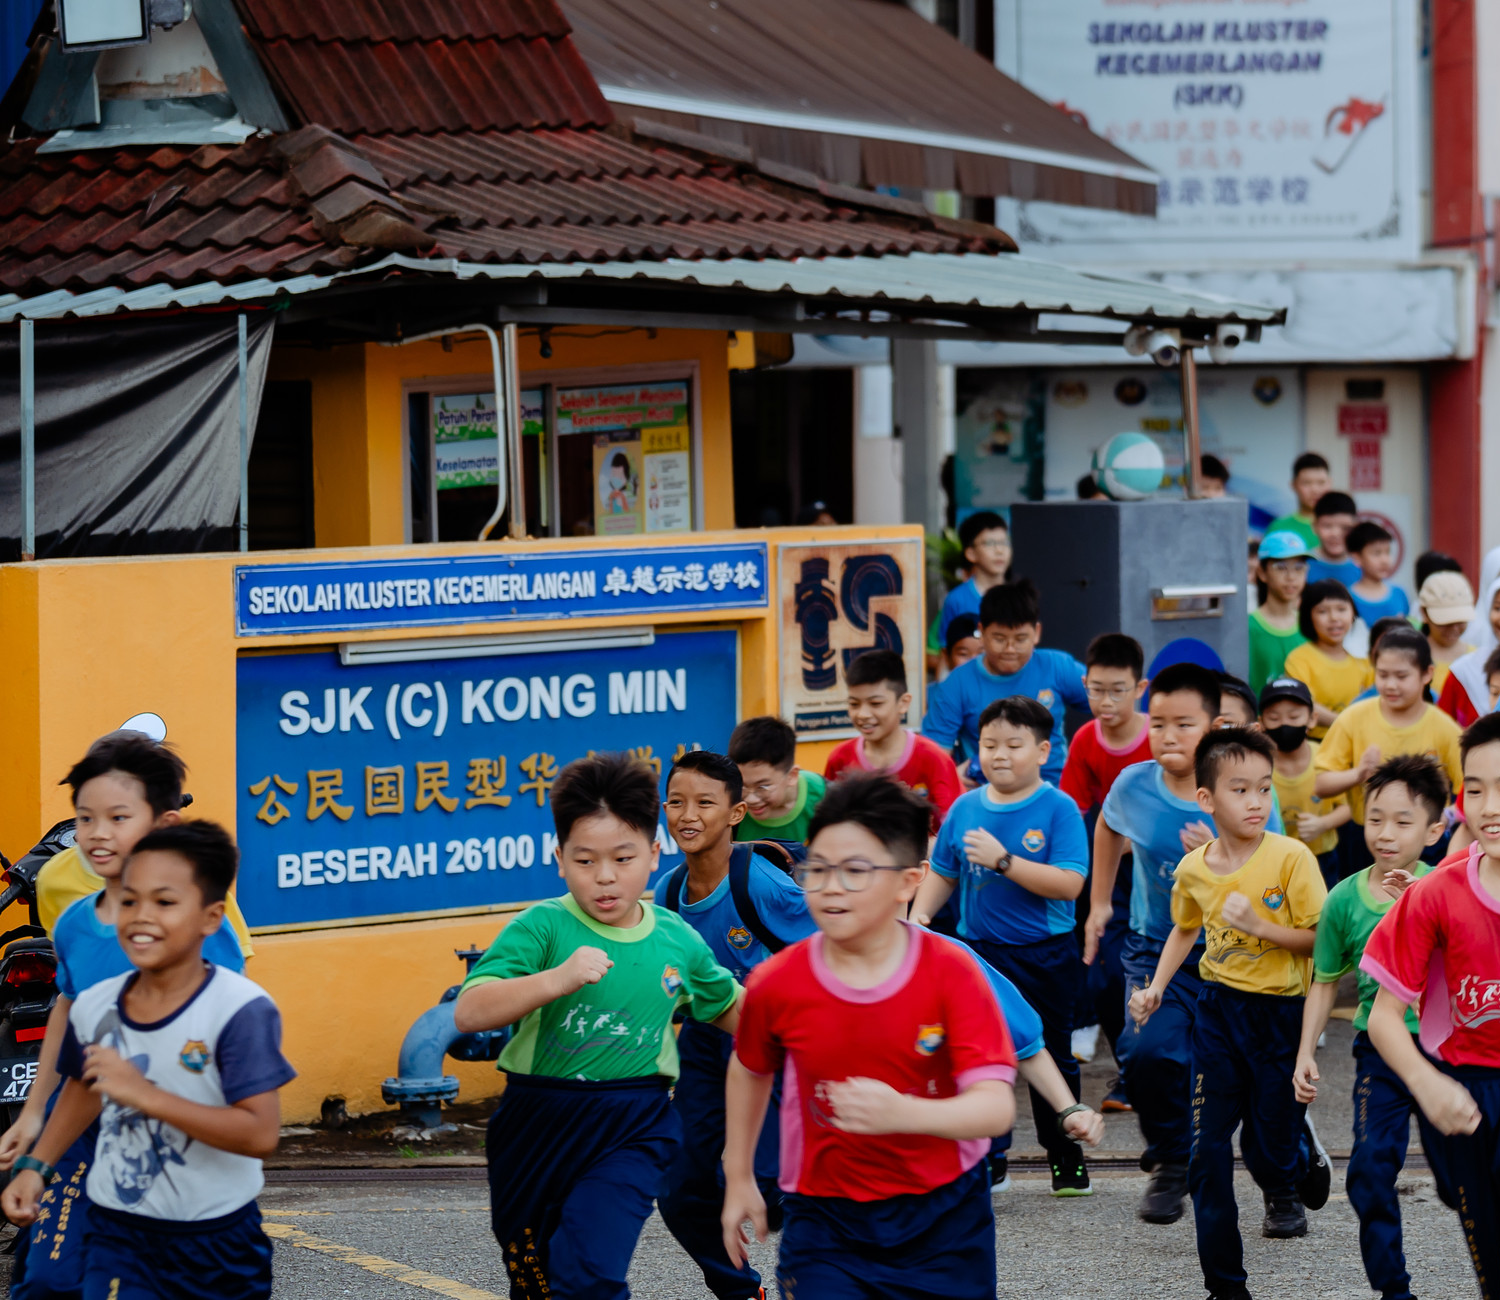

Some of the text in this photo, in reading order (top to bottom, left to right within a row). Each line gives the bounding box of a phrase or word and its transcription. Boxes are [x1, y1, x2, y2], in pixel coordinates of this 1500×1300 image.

[1088, 20, 1329, 46] SEKOLAH KLUSTER
[1095, 52, 1322, 76] KECEMERLANGAN
[1174, 83, 1244, 110] (SKK)
[560, 393, 596, 411] Sekolah
[598, 391, 636, 408] Selamat
[438, 407, 497, 427] Patuhi Perat
[572, 406, 675, 428] Kecemerlangan Murid
[436, 457, 498, 473] Keselamatan
[248, 559, 762, 616] SEKOLAH KLUSTER KECEMERLANGAN 卓越示范学校
[279, 668, 688, 740] SJK (C) KONG MIN
[276, 840, 438, 890] BESERAH
[445, 833, 537, 877] 26100
[524, 1256, 539, 1264] (C)
[532, 1266, 550, 1293] KONG
